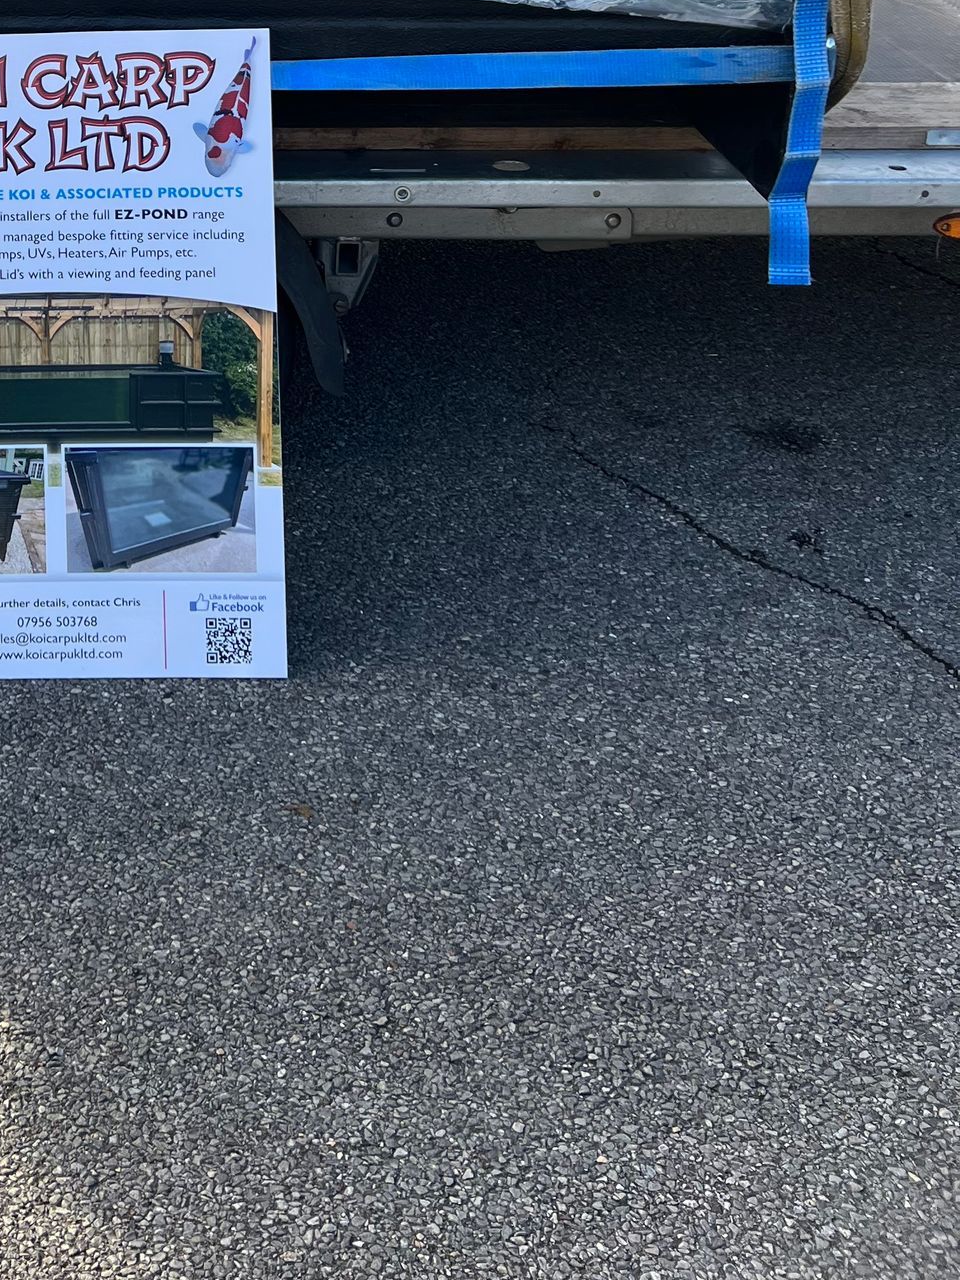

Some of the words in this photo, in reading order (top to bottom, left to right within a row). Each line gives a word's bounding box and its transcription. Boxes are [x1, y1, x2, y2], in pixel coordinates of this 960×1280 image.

[20, 50, 216, 111] CARP
[45, 114, 171, 175] LTD
[9, 189, 35, 200] KOI
[40, 189, 50, 200] &
[56, 187, 153, 199] ASSOCIATED
[158, 186, 244, 198] PRODUCTS
[0, 211, 50, 221] installers
[55, 210, 67, 220] of
[70, 210, 89, 220] the
[93, 210, 110, 220] full
[114, 209, 188, 220] EZ-POND
[192, 210, 225, 222] range
[3, 231, 54, 244] managed
[58, 230, 106, 243] bespoke
[110, 229, 144, 243] fitting
[147, 230, 189, 240] service
[193, 229, 245, 242] including
[28, 248, 55, 260] UVs,
[58, 247, 107, 260] Heaters,
[108, 247, 127, 258] Air
[131, 247, 172, 260] Pumps,
[176, 248, 197, 257] etc.
[0, 269, 24, 280] Lid's
[28, 269, 54, 280] with
[57, 271, 64, 279] a
[68, 268, 111, 281] viewing
[115, 268, 135, 279] and
[139, 267, 181, 281] feeding
[185, 267, 216, 280] panel
[33, 598, 69, 609] details,
[72, 598, 110, 608] contact
[114, 597, 141, 607] Chris
[212, 602, 264, 612] Facebook
[17, 616, 52, 628] 07956
[56, 616, 98, 628] 503768
